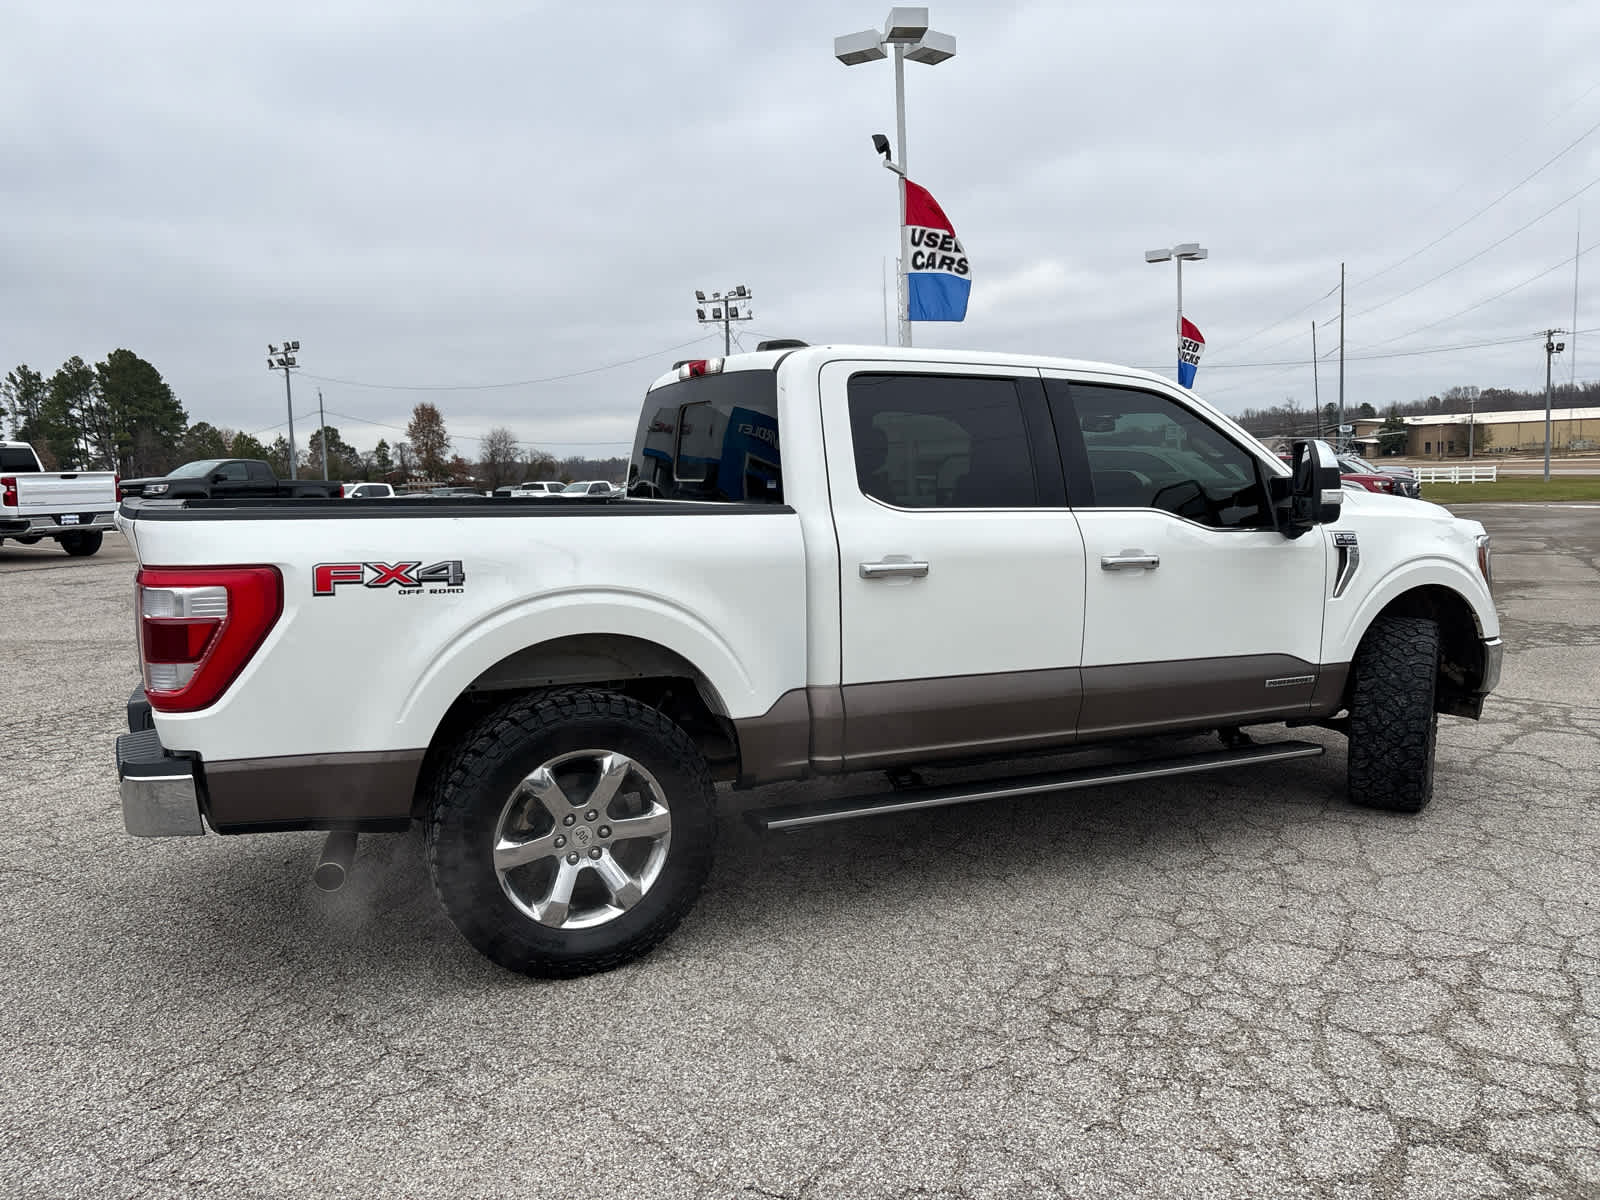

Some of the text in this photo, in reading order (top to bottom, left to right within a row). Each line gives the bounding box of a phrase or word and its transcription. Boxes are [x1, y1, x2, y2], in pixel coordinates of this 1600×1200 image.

[912, 250, 969, 275] CARS
[1181, 338, 1200, 353] SED
[312, 560, 465, 597] FX4
